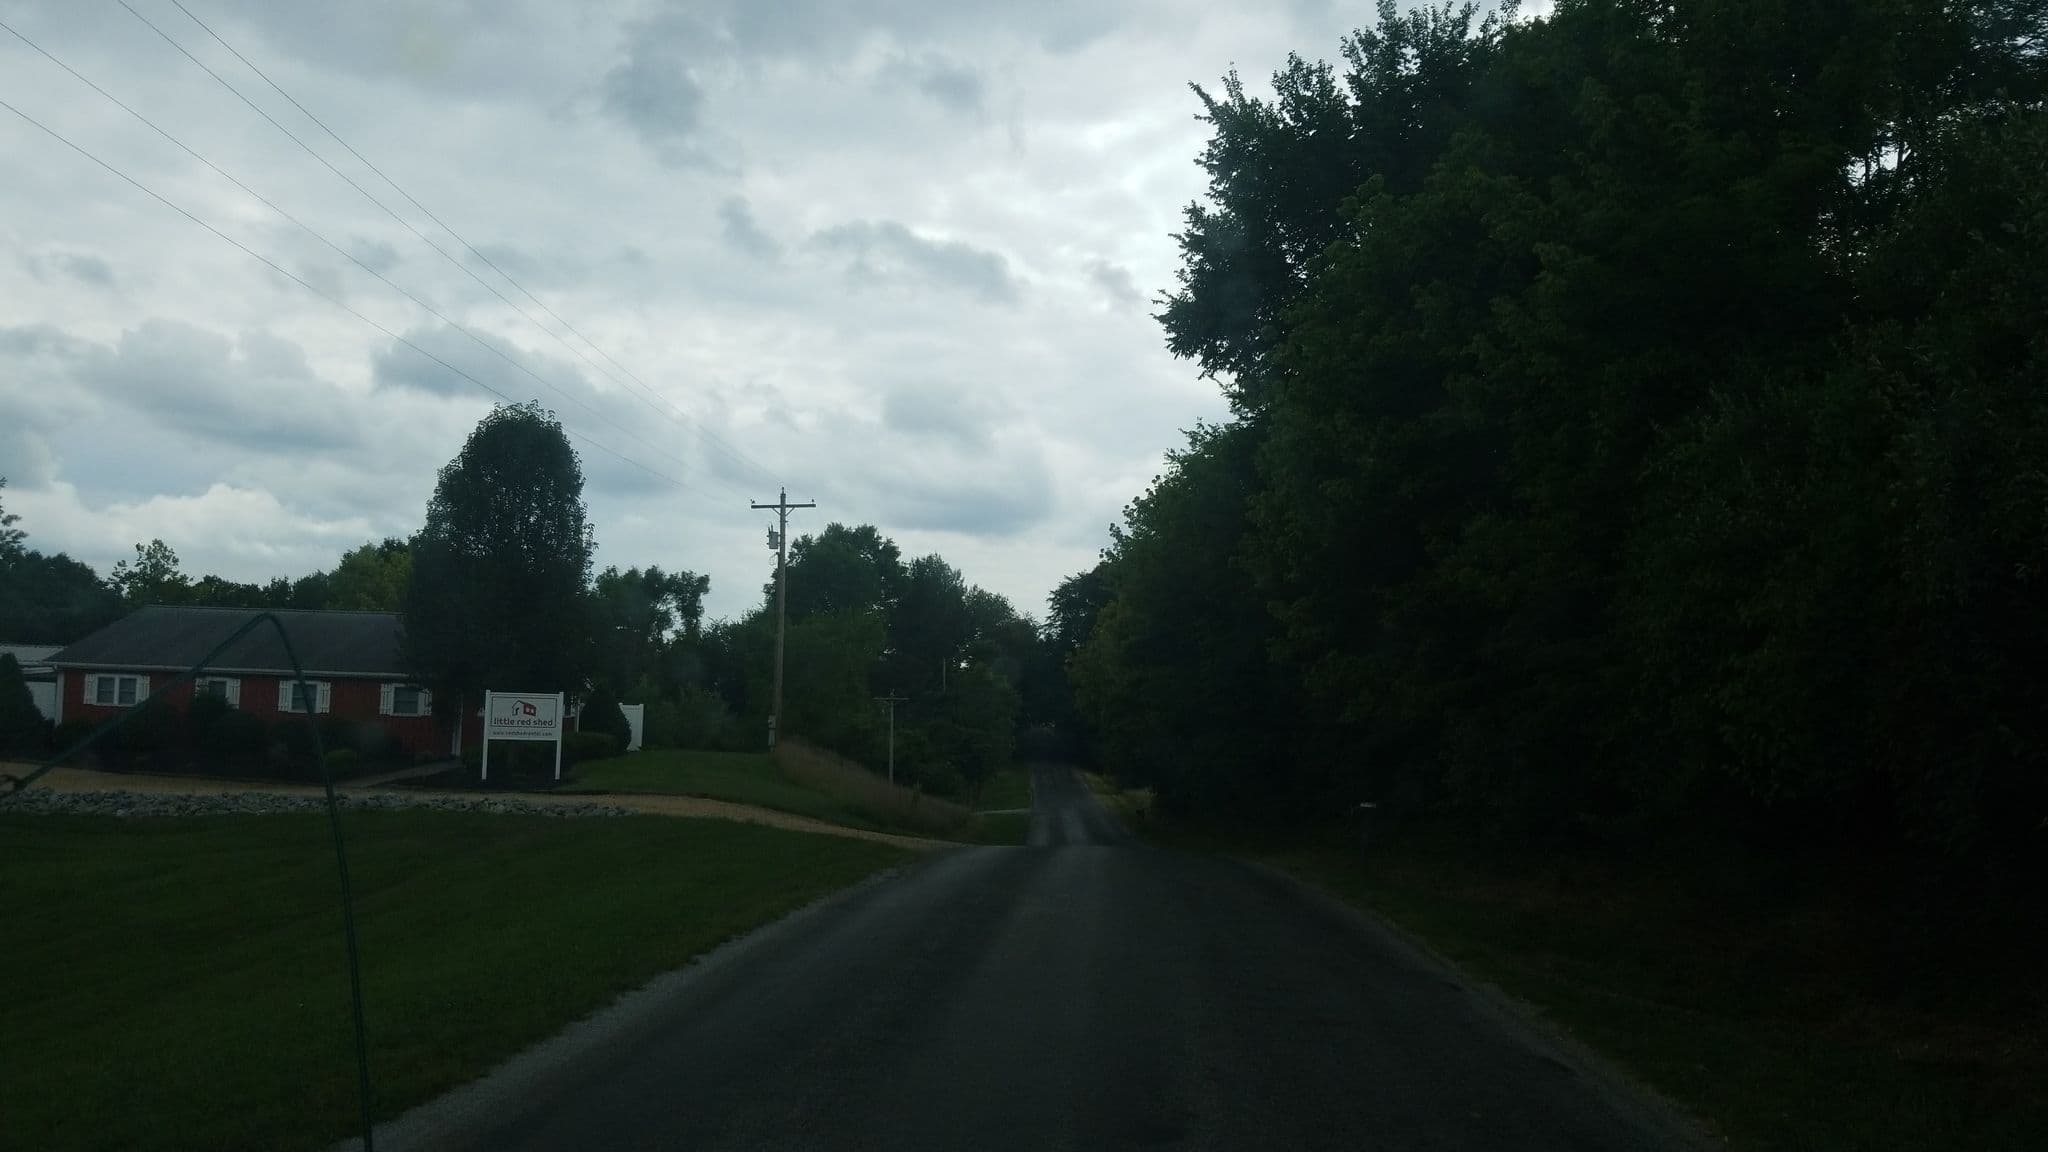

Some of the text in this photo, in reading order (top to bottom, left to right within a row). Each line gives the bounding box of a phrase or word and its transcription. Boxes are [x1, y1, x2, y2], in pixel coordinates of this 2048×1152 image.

[493, 717, 553, 726] little red shed
